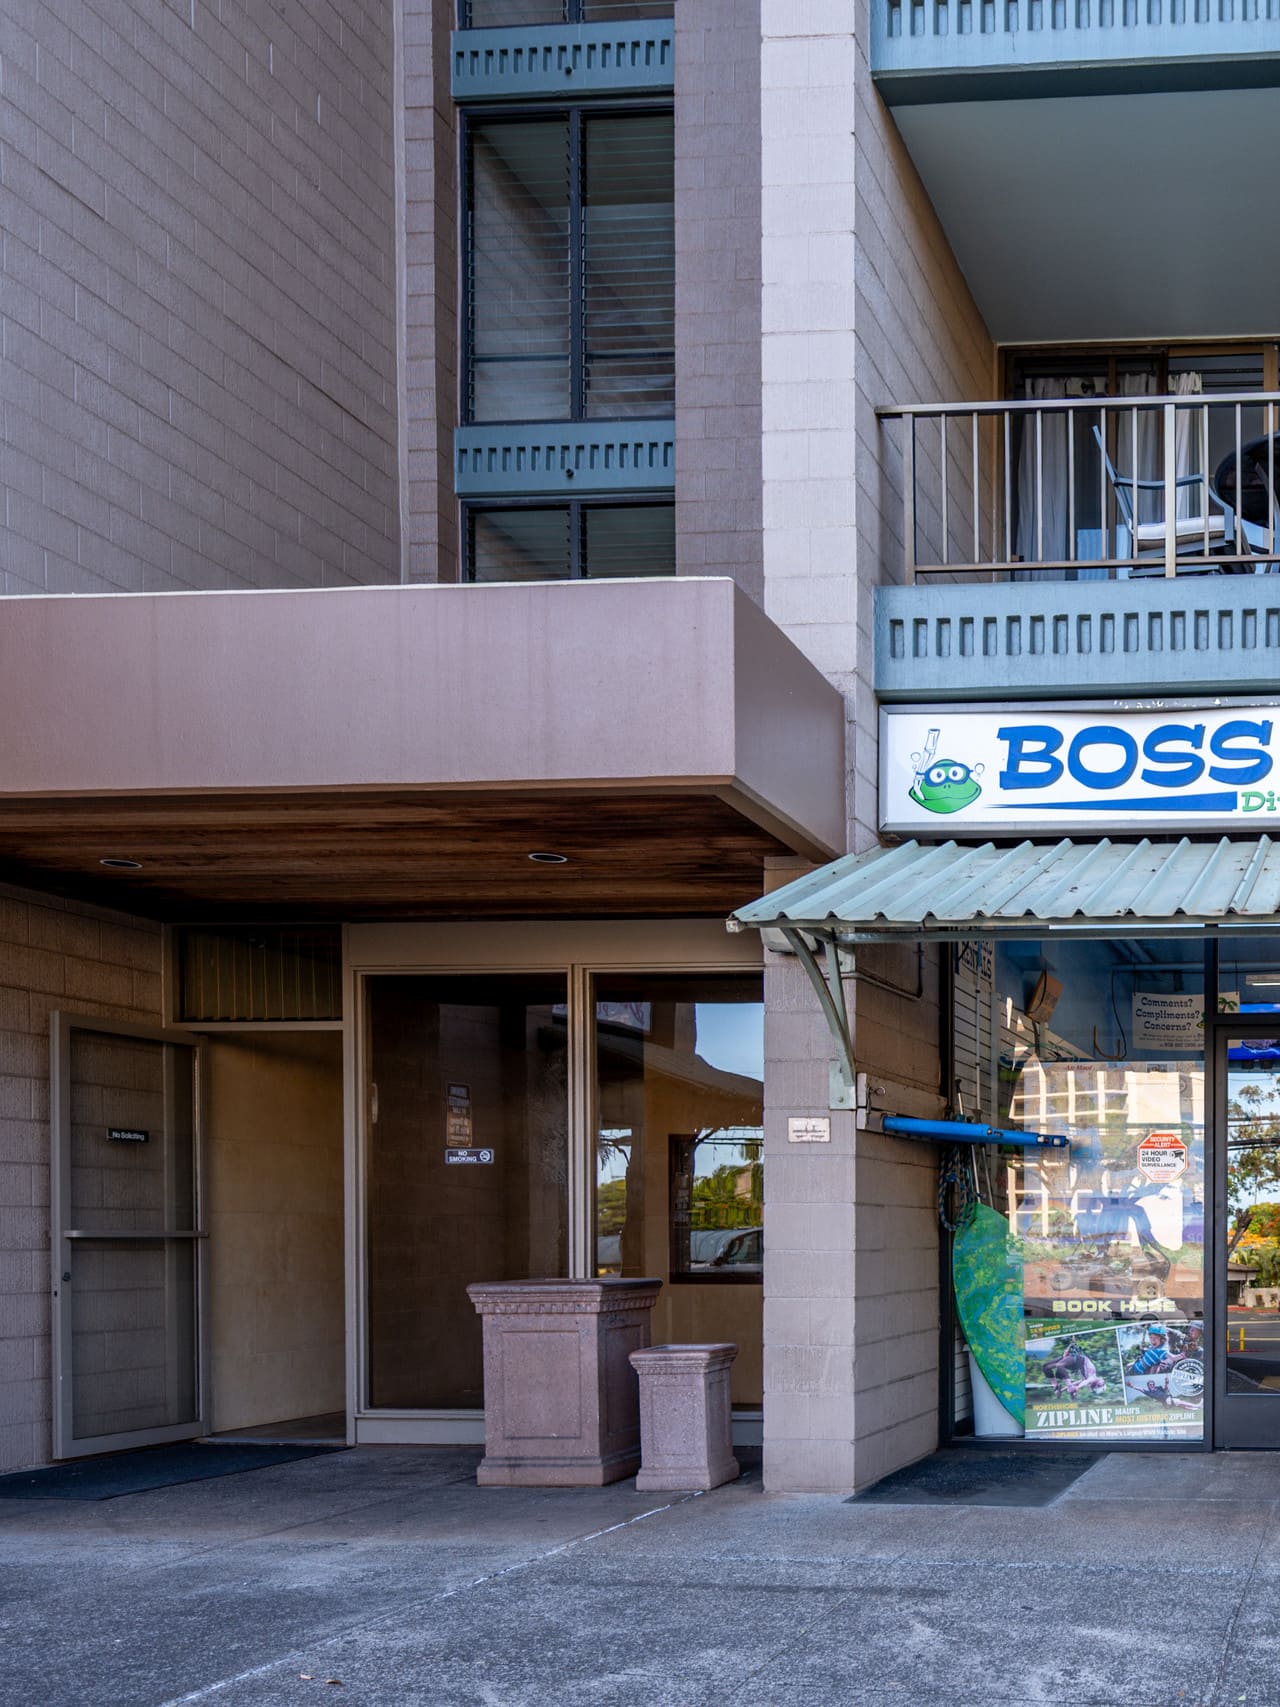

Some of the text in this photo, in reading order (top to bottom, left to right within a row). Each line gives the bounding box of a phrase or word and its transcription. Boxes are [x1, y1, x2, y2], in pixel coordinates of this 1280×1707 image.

[997, 719, 1274, 790] BOSS
[1141, 997, 1194, 1008] Comments?
[1136, 1009, 1200, 1020] Compliments?
[1144, 1021, 1192, 1031] Concerns?
[1053, 1300, 1176, 1312] BOOK HERE
[1036, 1407, 1113, 1427] ZIPLINE
[1169, 1412, 1196, 1420] ZIPLINE
